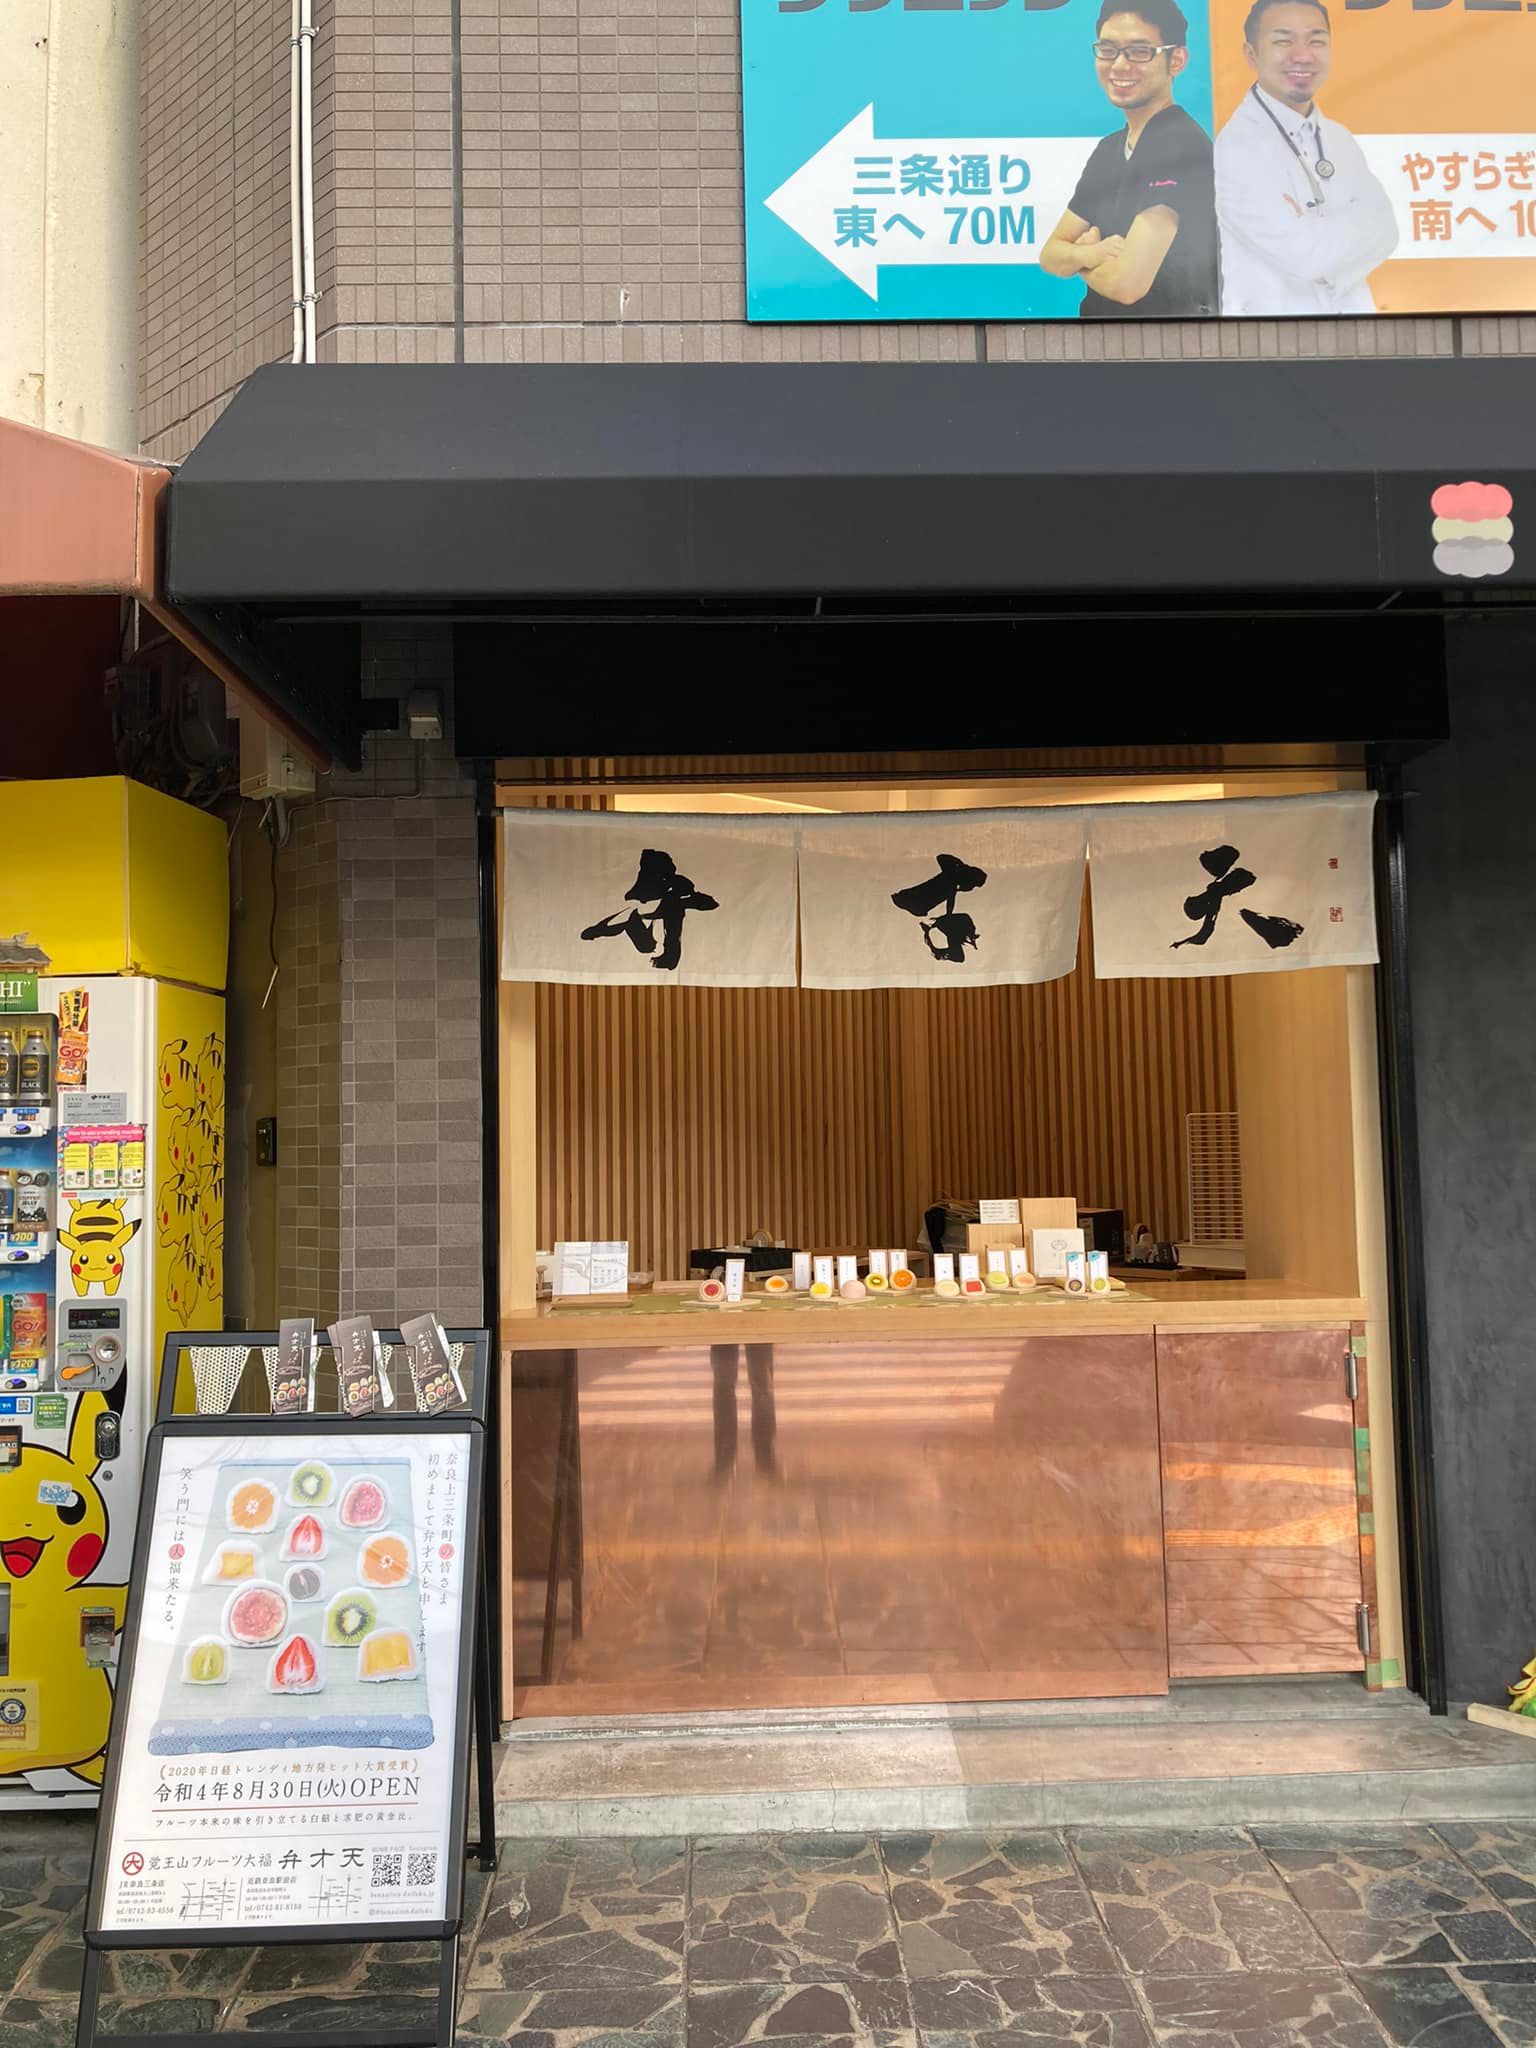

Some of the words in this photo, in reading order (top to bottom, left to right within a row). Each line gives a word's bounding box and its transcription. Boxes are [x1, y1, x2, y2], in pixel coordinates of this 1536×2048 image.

[853, 153, 1031, 196] 三条通り
[1401, 151, 1536, 191] やすらぎ
[834, 204, 925, 248] 東へ
[943, 205, 1035, 245] 70M
[1409, 198, 1498, 241] 南へ
[278, 1848, 365, 1870] 弁才天
